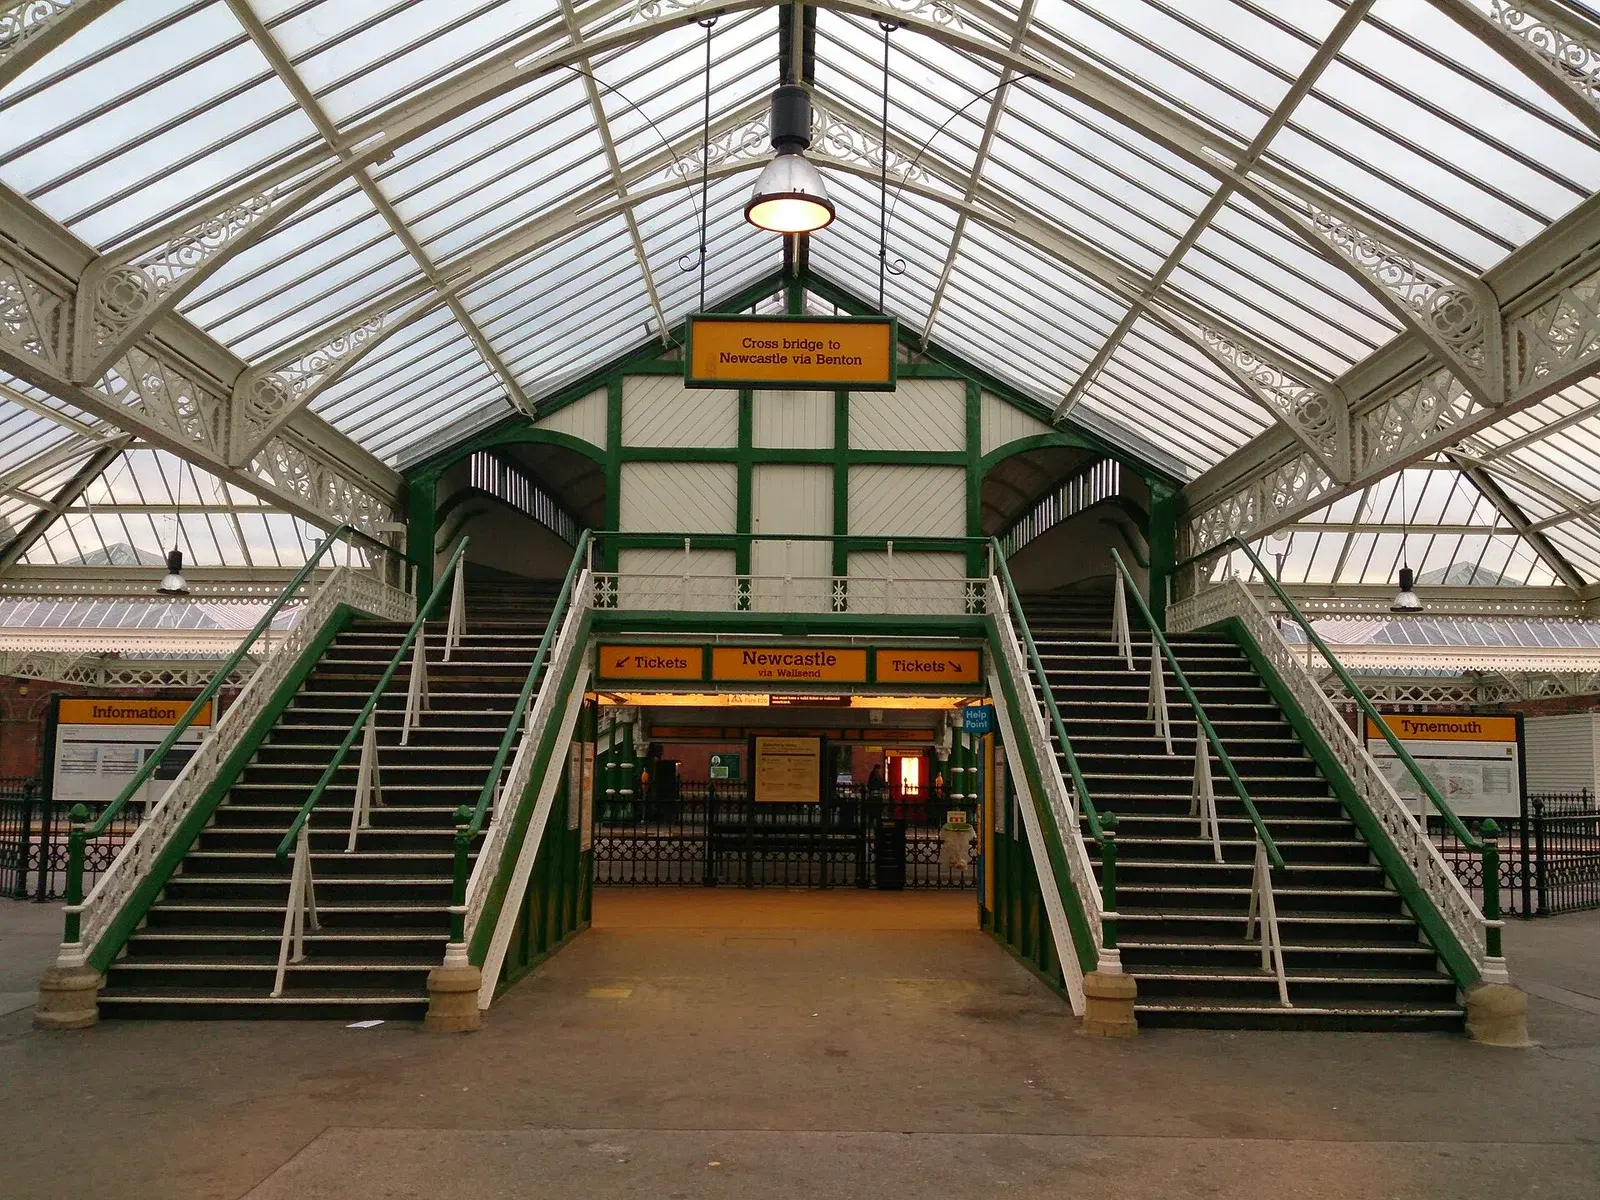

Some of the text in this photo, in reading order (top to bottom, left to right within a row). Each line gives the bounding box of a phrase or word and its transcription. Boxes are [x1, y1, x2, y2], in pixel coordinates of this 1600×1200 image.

[742, 337, 841, 352] Cross bridge to
[719, 352, 862, 365] Newcastle via Benton
[634, 655, 687, 669] Tickets
[743, 650, 836, 667] Newcastle
[758, 668, 821, 678] via Wallsend
[892, 659, 945, 673] Tickets
[92, 705, 176, 719] Information
[966, 710, 987, 720] Help
[966, 720, 988, 728] Point
[1401, 720, 1482, 735] Tynemouth
